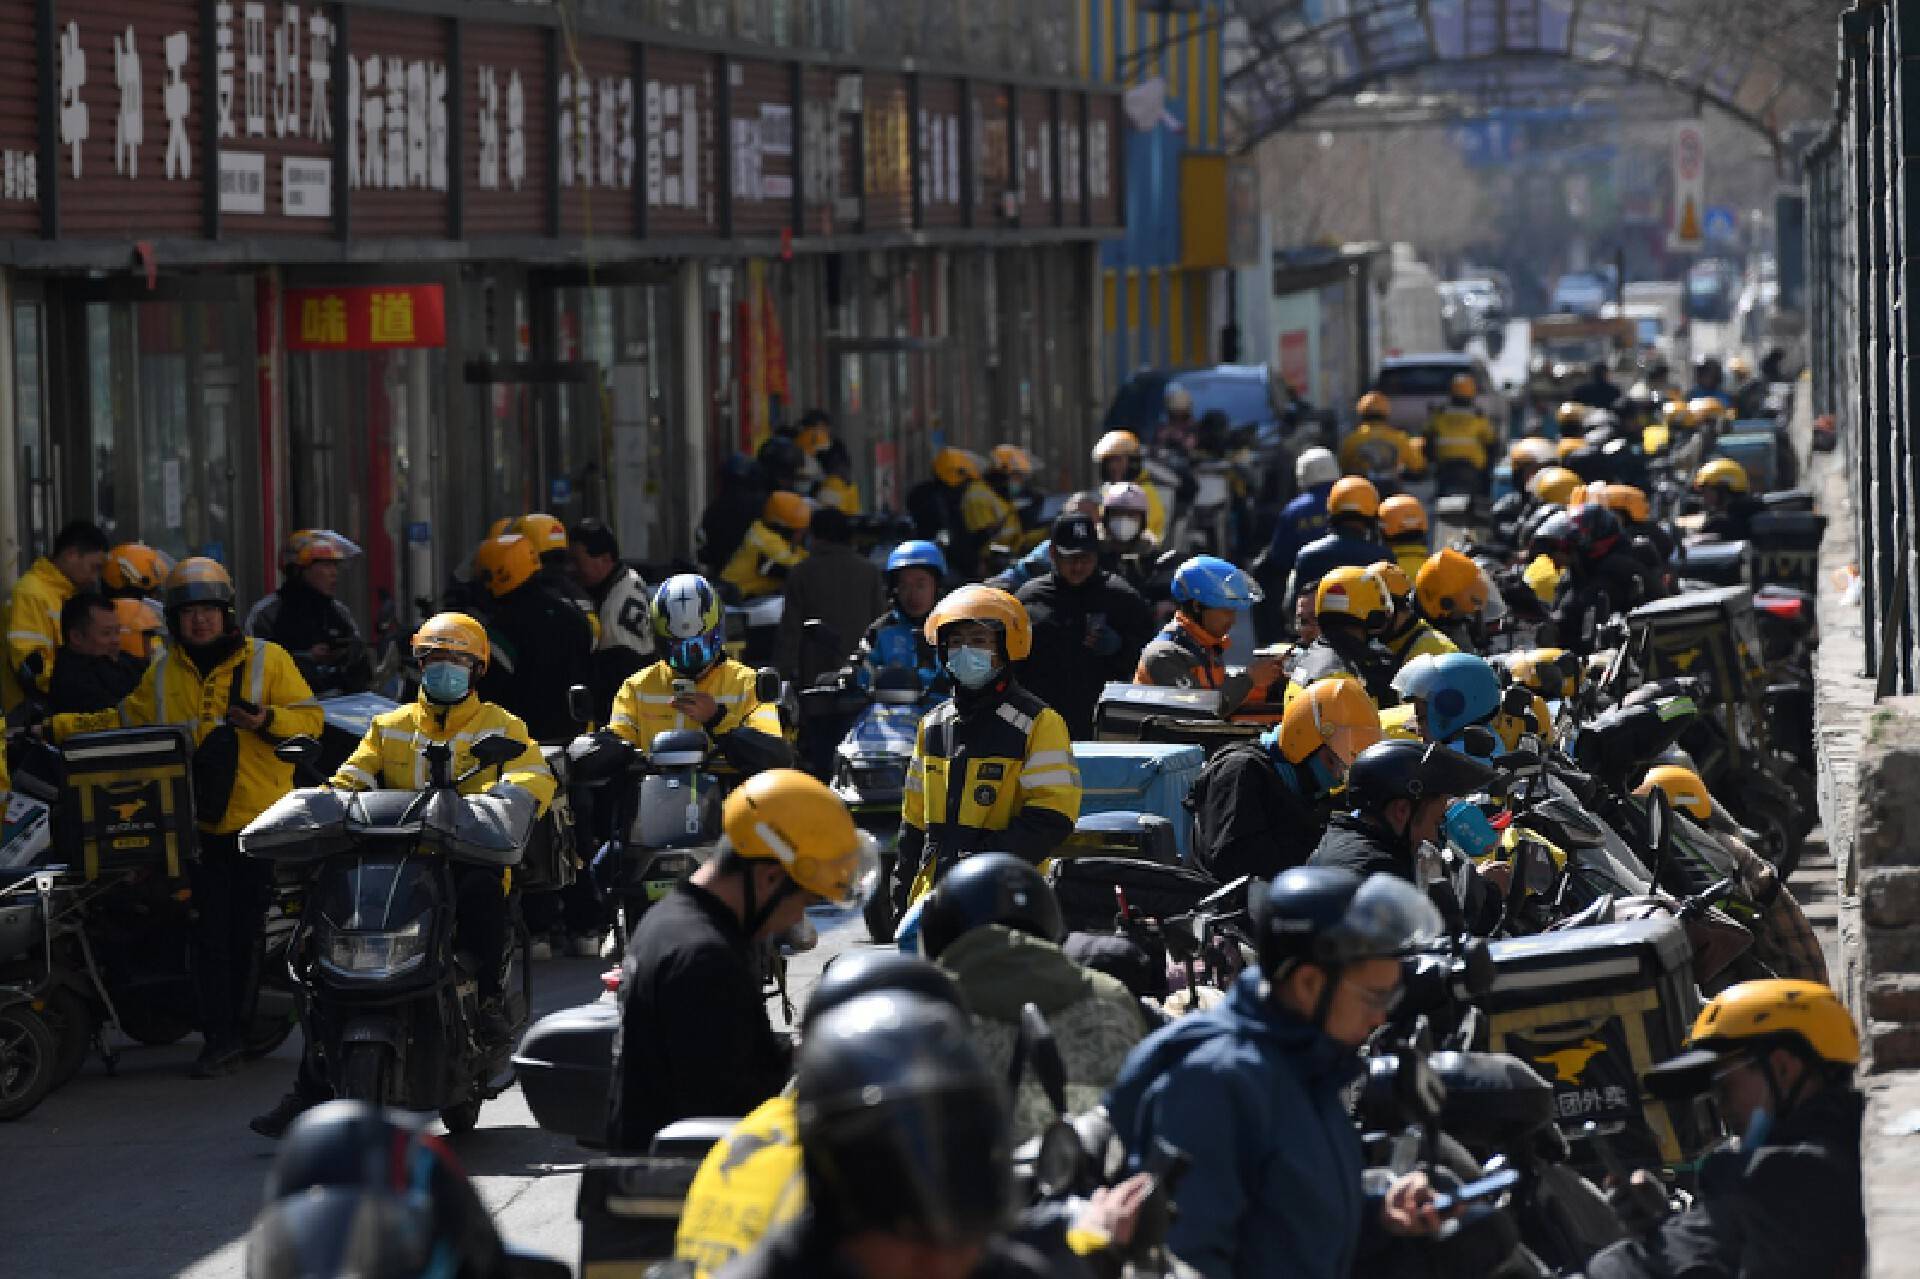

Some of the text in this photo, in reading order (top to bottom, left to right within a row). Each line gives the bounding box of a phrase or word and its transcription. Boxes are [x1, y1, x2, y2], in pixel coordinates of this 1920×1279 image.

[302, 292, 415, 342] 味道
[1555, 1086, 1627, 1116] 团外卖
